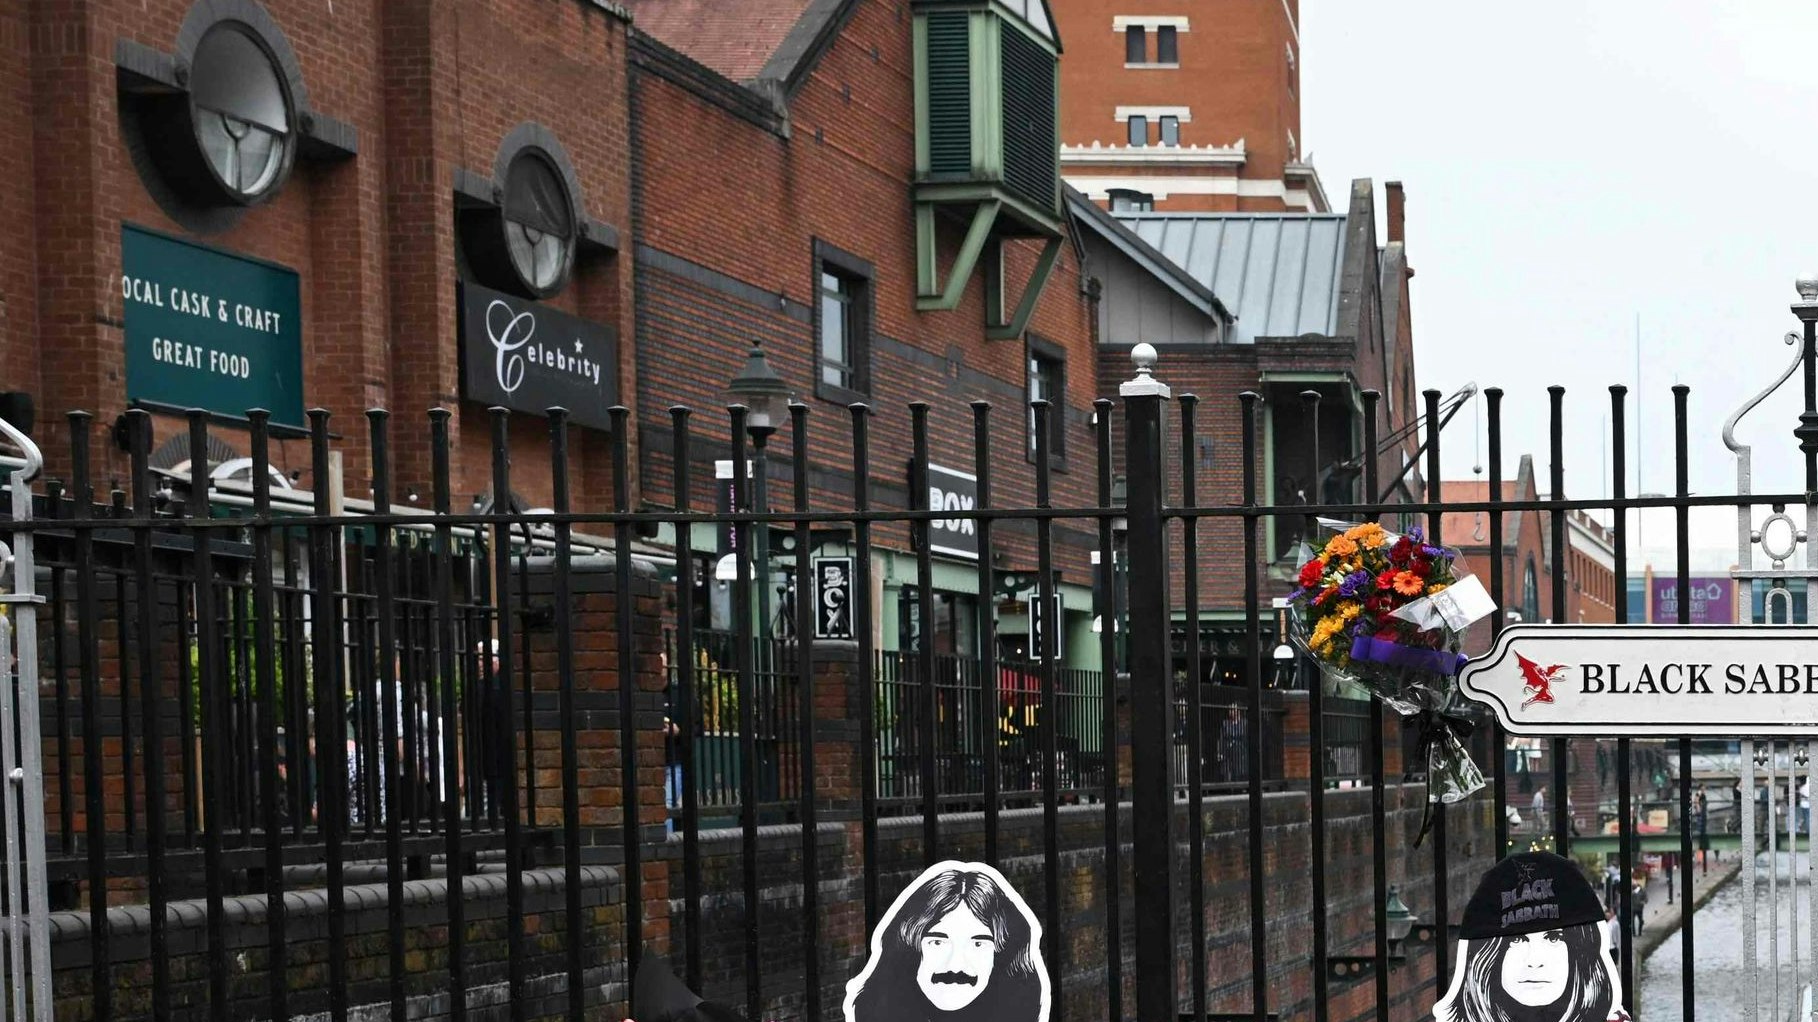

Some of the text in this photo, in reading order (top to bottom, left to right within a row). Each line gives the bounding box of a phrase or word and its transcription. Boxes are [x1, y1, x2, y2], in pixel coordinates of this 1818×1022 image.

[122, 275, 281, 334] OCAL CASK & CRAFT
[152, 337, 250, 379] GREAT FOOD
[486, 300, 600, 399] Celebrity
[929, 486, 974, 536] BOX
[1579, 663, 1714, 695] BLACK
[1501, 878, 1555, 910] BLACK
[1501, 904, 1560, 929] SABBATH
